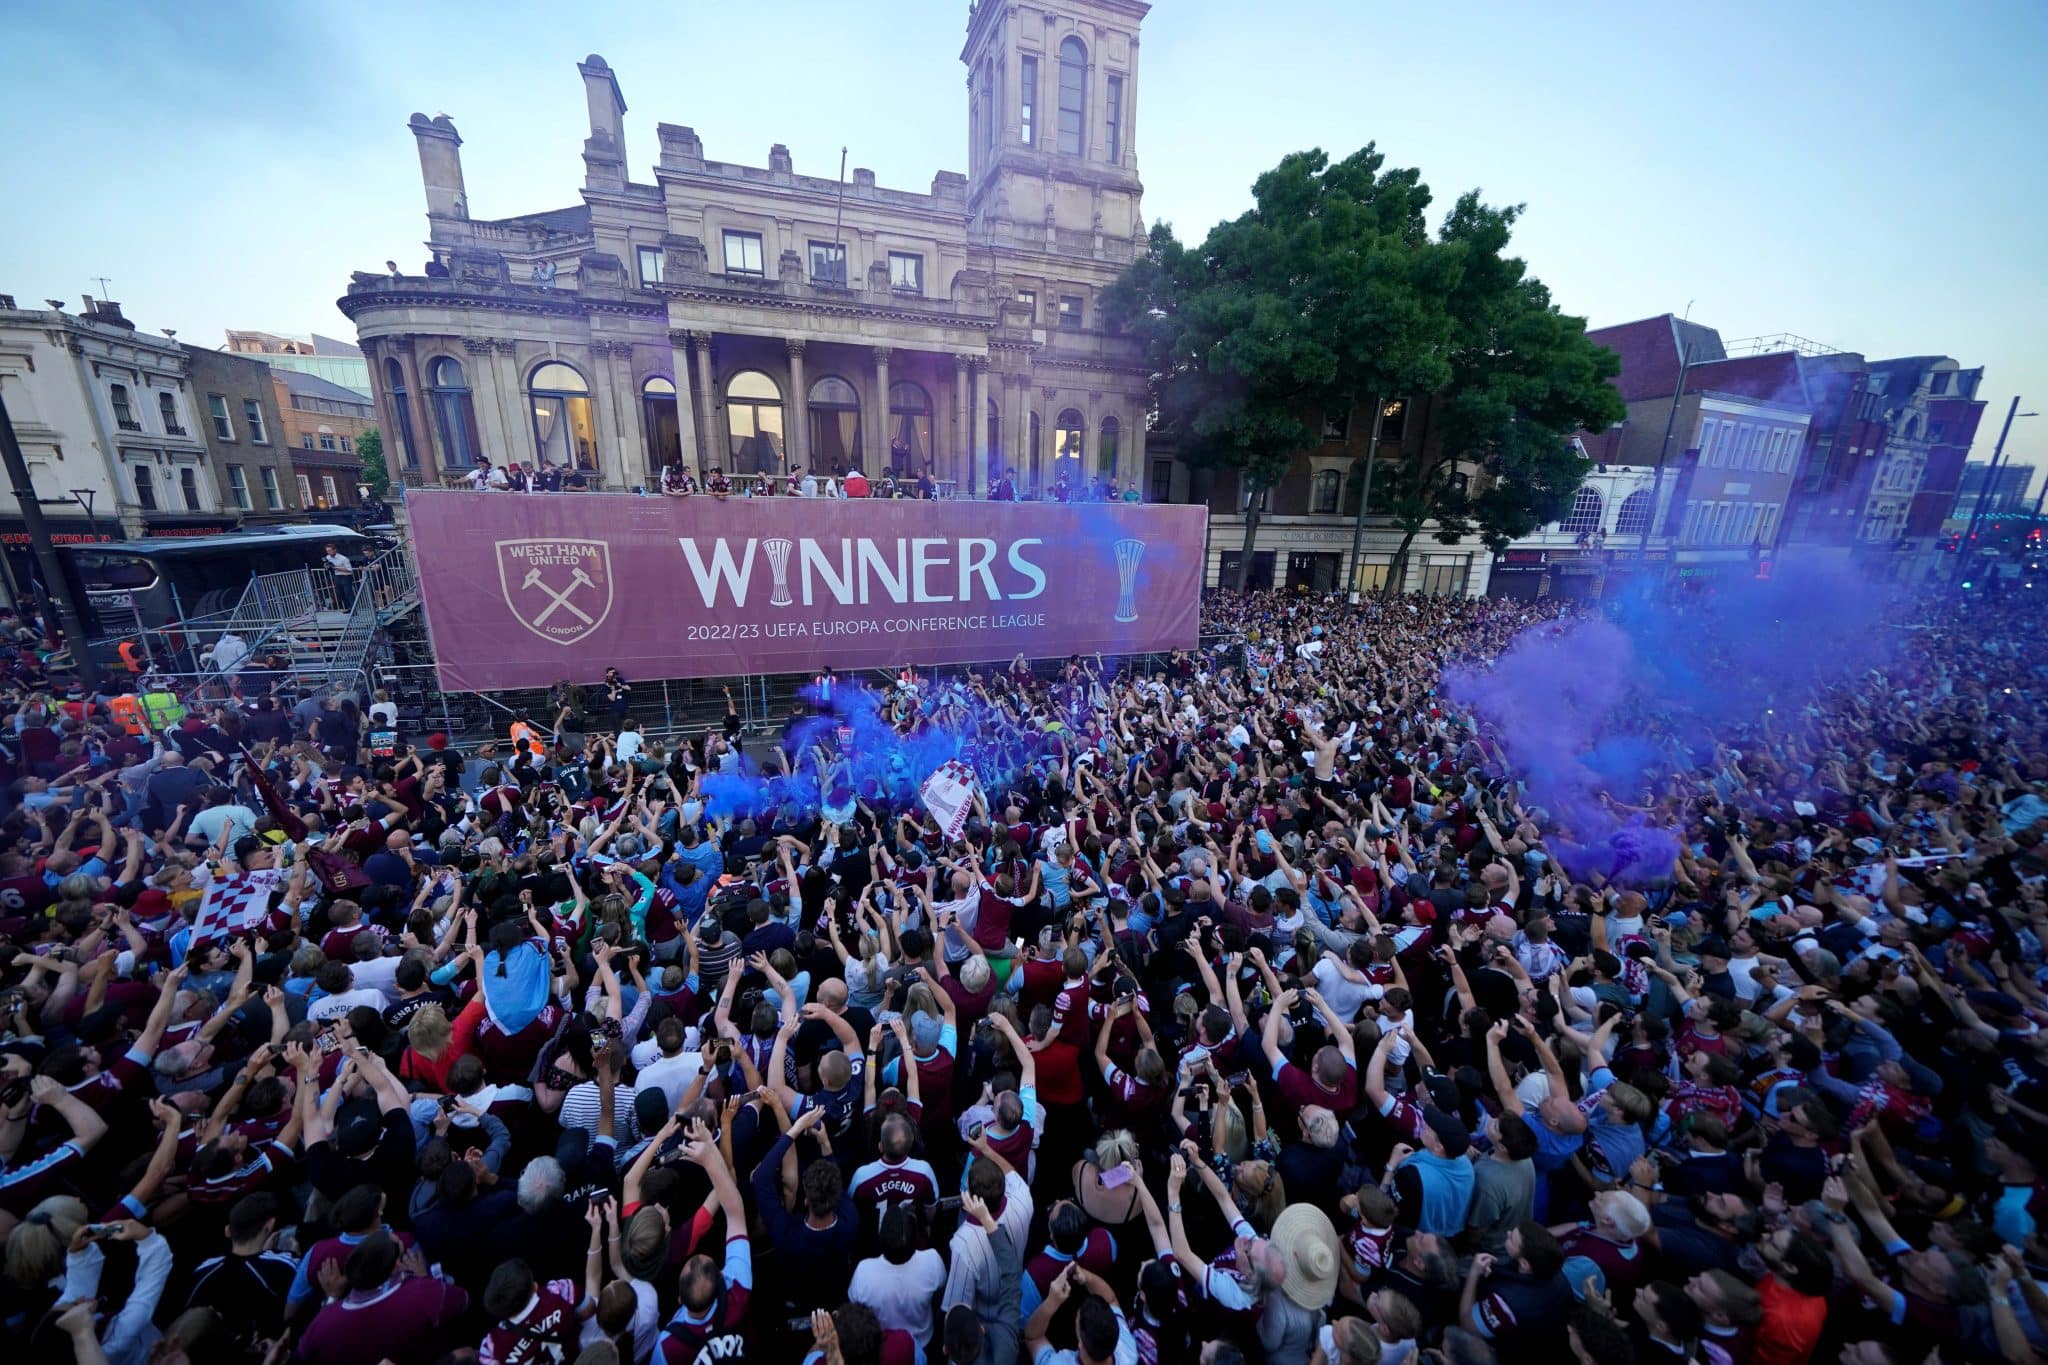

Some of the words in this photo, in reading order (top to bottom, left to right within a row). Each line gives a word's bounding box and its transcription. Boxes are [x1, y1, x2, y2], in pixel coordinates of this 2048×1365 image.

[510, 544, 554, 558] WEST
[557, 544, 597, 558] HAM
[529, 555, 581, 566] UNITED
[545, 624, 583, 635] LONDON
[687, 624, 760, 641] 2022/23
[764, 621, 808, 638] UEFA
[812, 619, 881, 636] EUROPA
[883, 616, 988, 633] CONFERENCE
[991, 613, 1046, 629] LEAGUE
[390, 1001, 442, 1026] BENRA
[874, 1180, 916, 1197] LEGEND
